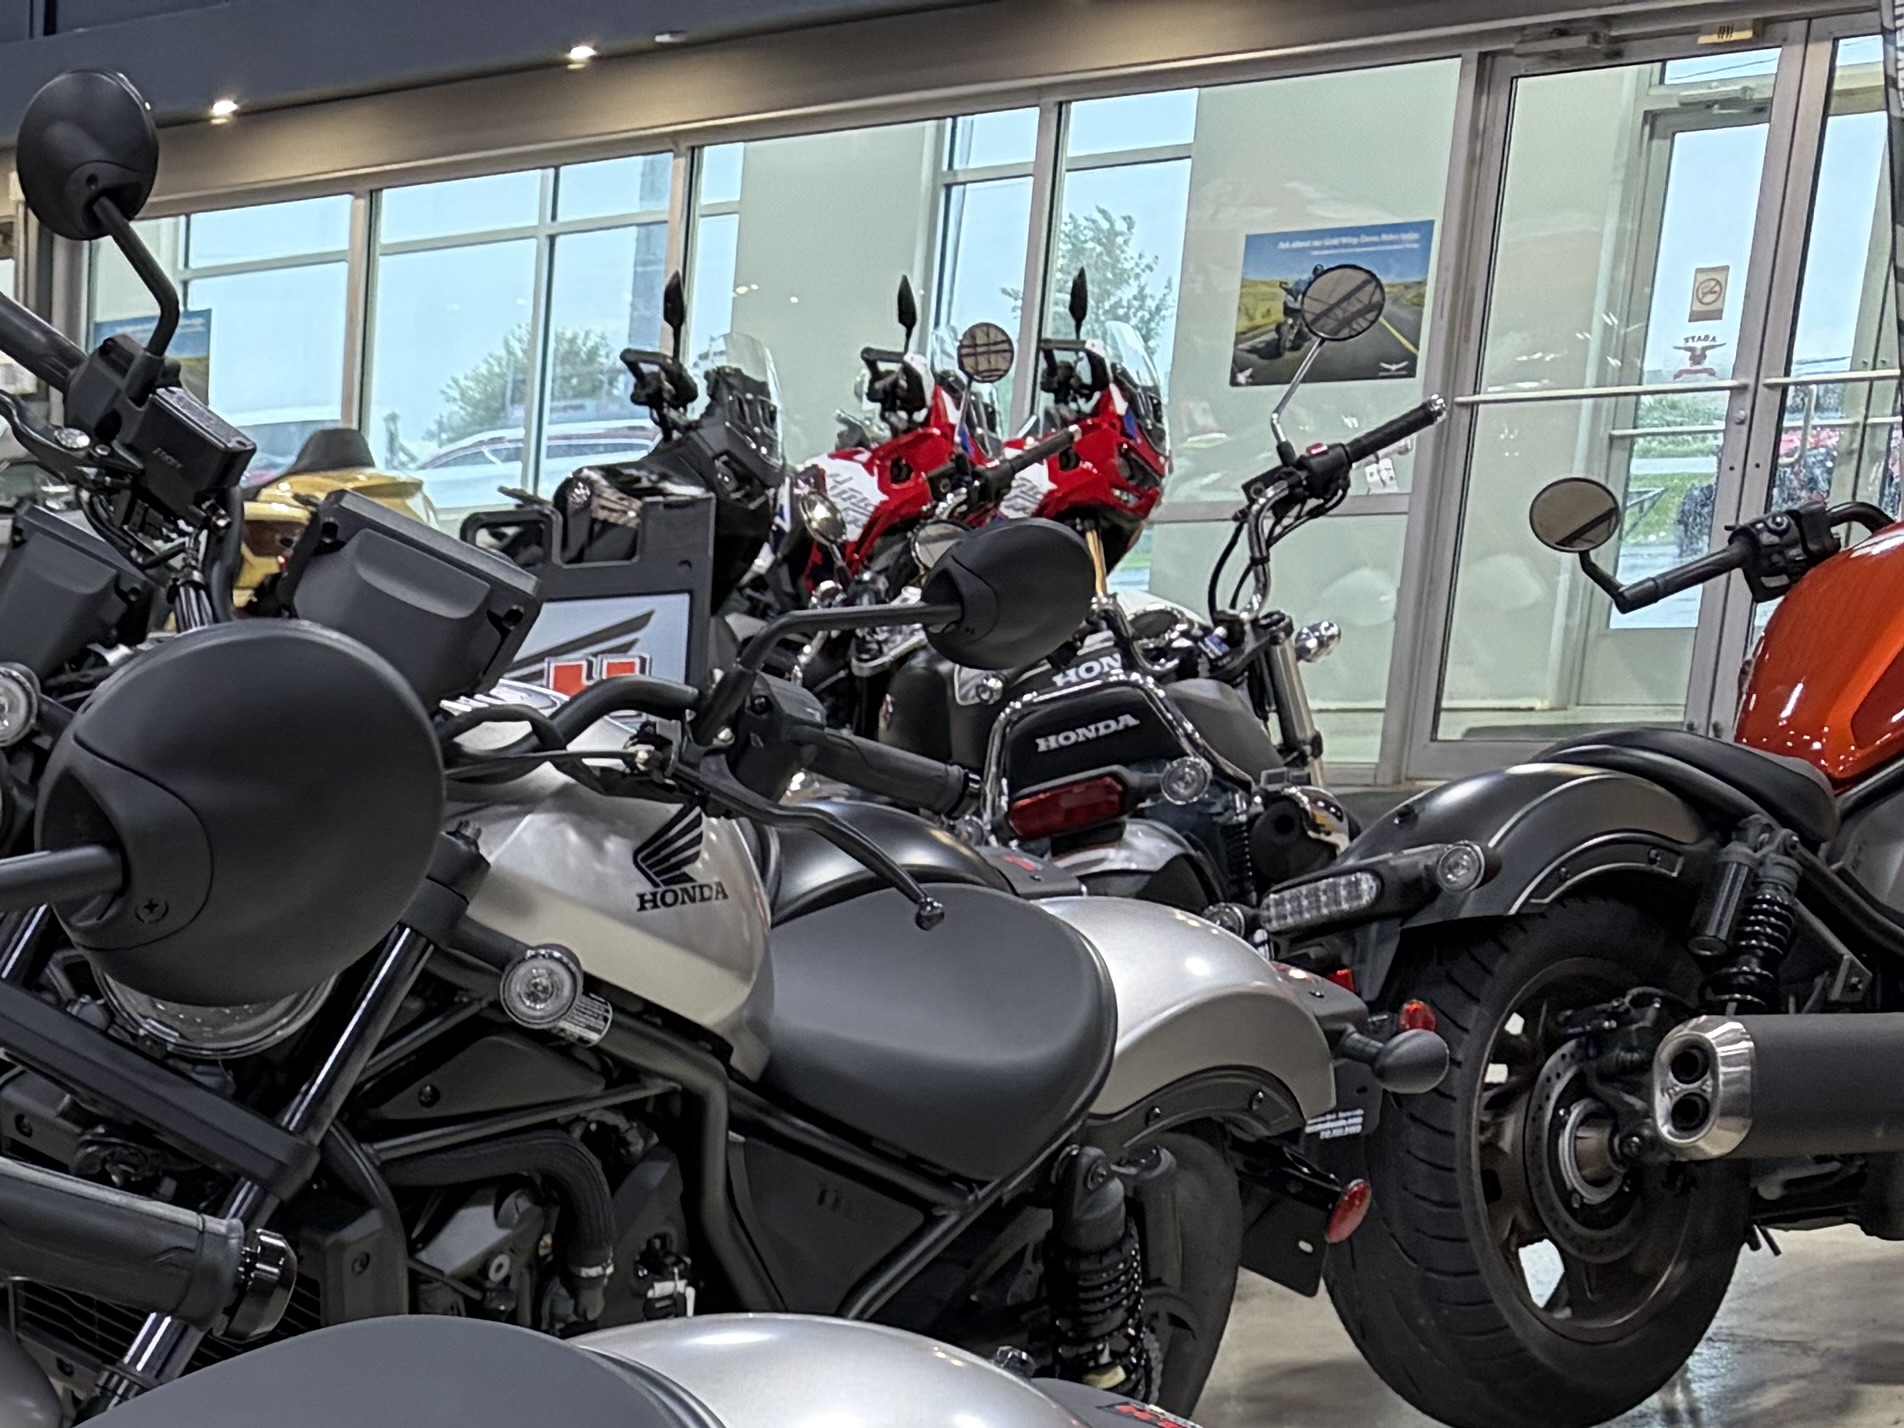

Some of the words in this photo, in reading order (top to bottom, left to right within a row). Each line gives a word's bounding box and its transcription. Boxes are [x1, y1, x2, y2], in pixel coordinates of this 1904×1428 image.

[1052, 653, 1122, 688] HON
[1035, 713, 1141, 753] HONDA
[635, 881, 730, 913] HONDA
